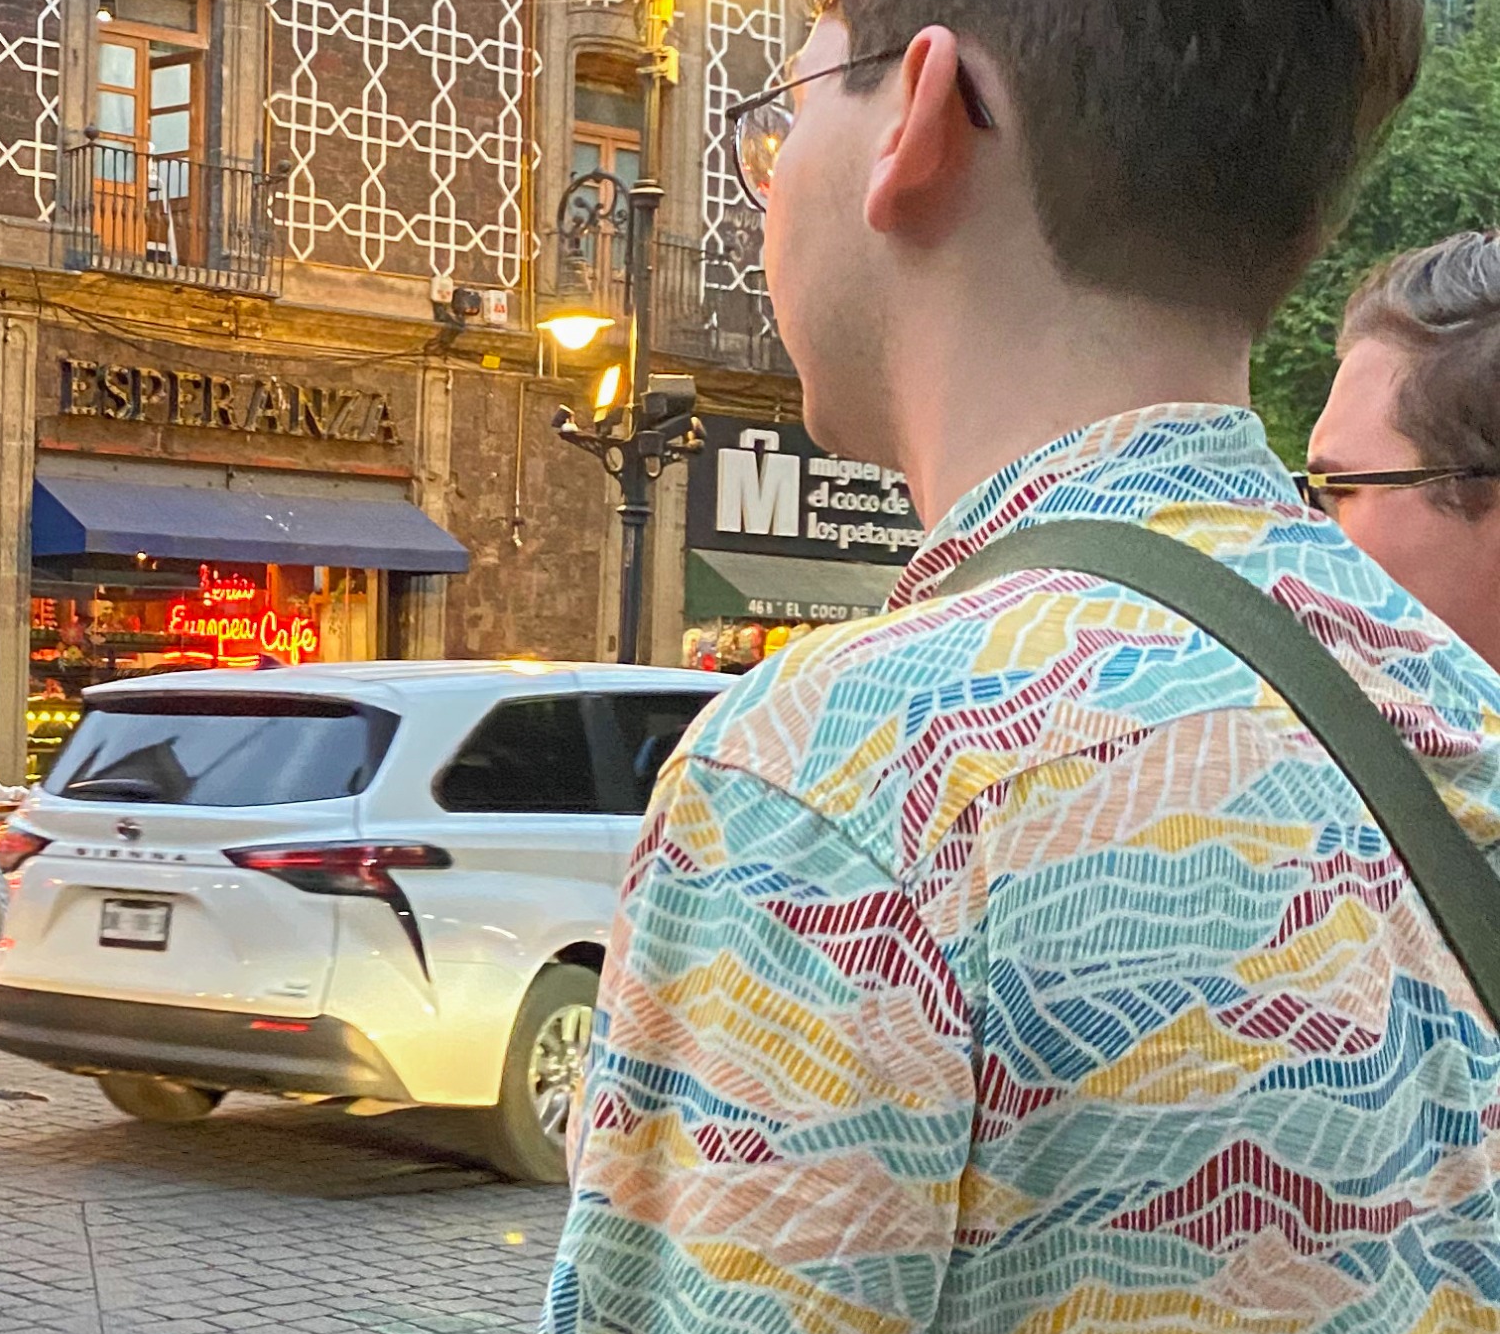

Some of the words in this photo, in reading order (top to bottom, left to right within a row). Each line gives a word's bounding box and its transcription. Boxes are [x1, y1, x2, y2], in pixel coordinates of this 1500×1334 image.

[60, 357, 402, 445] ESPERANZA
[807, 481, 830, 509] el
[830, 491, 881, 512] coco
[881, 488, 910, 515] de
[806, 512, 839, 540] los
[786, 601, 802, 617] EL
[810, 603, 848, 619] COCO
[259, 610, 318, 666] Café
[75, 846, 188, 863] SIENNA
